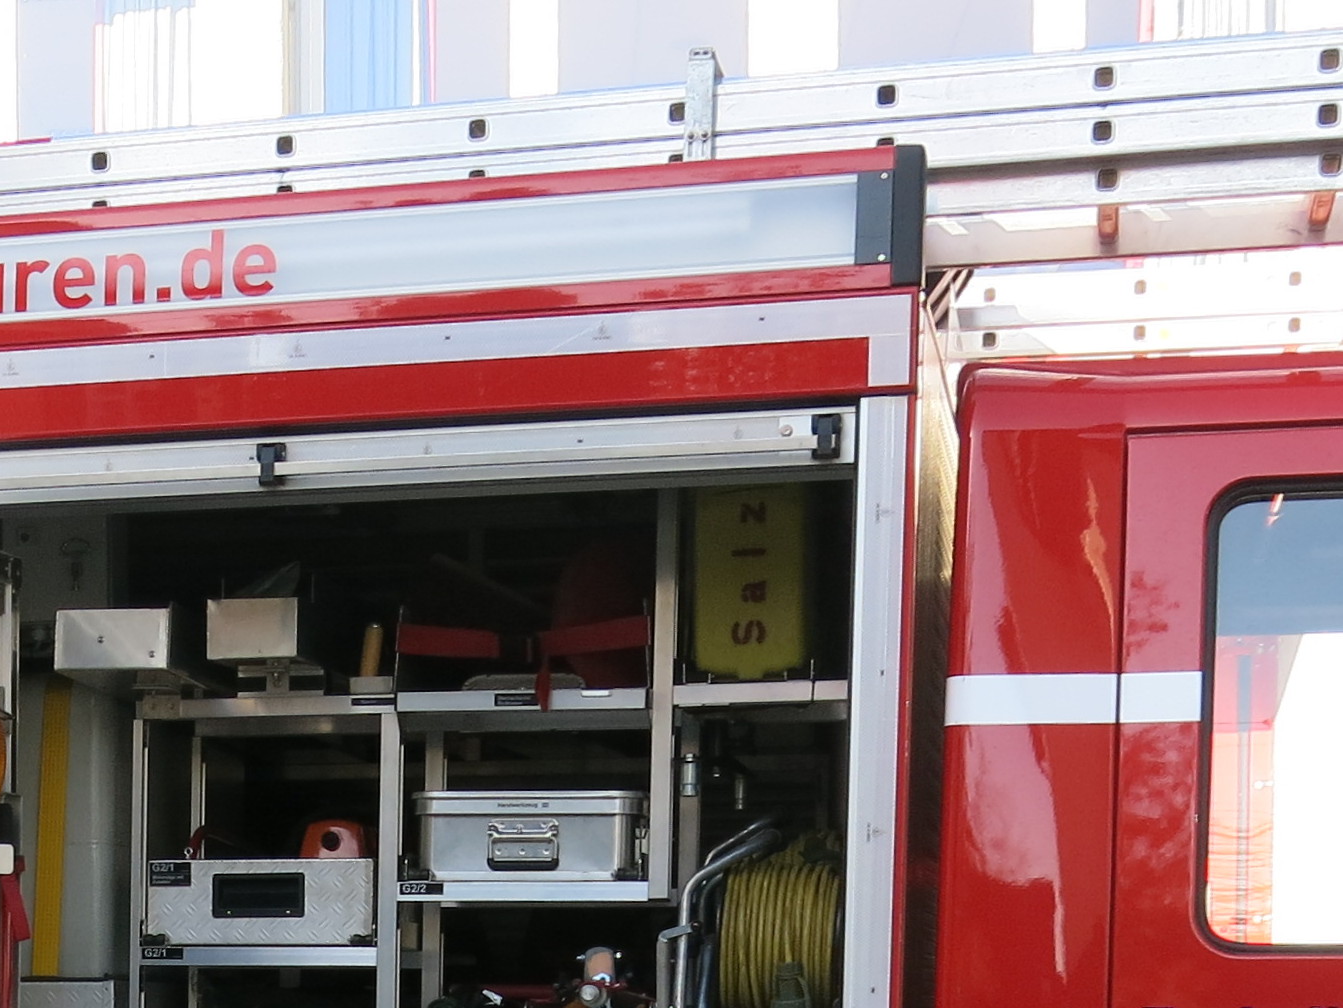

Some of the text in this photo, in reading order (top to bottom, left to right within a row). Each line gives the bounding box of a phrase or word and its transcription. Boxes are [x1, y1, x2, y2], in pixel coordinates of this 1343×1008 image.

[730, 501, 767, 646] Salz
[152, 863, 175, 873] G2/1
[402, 883, 427, 893] G2/2
[144, 948, 167, 958] G2/1
